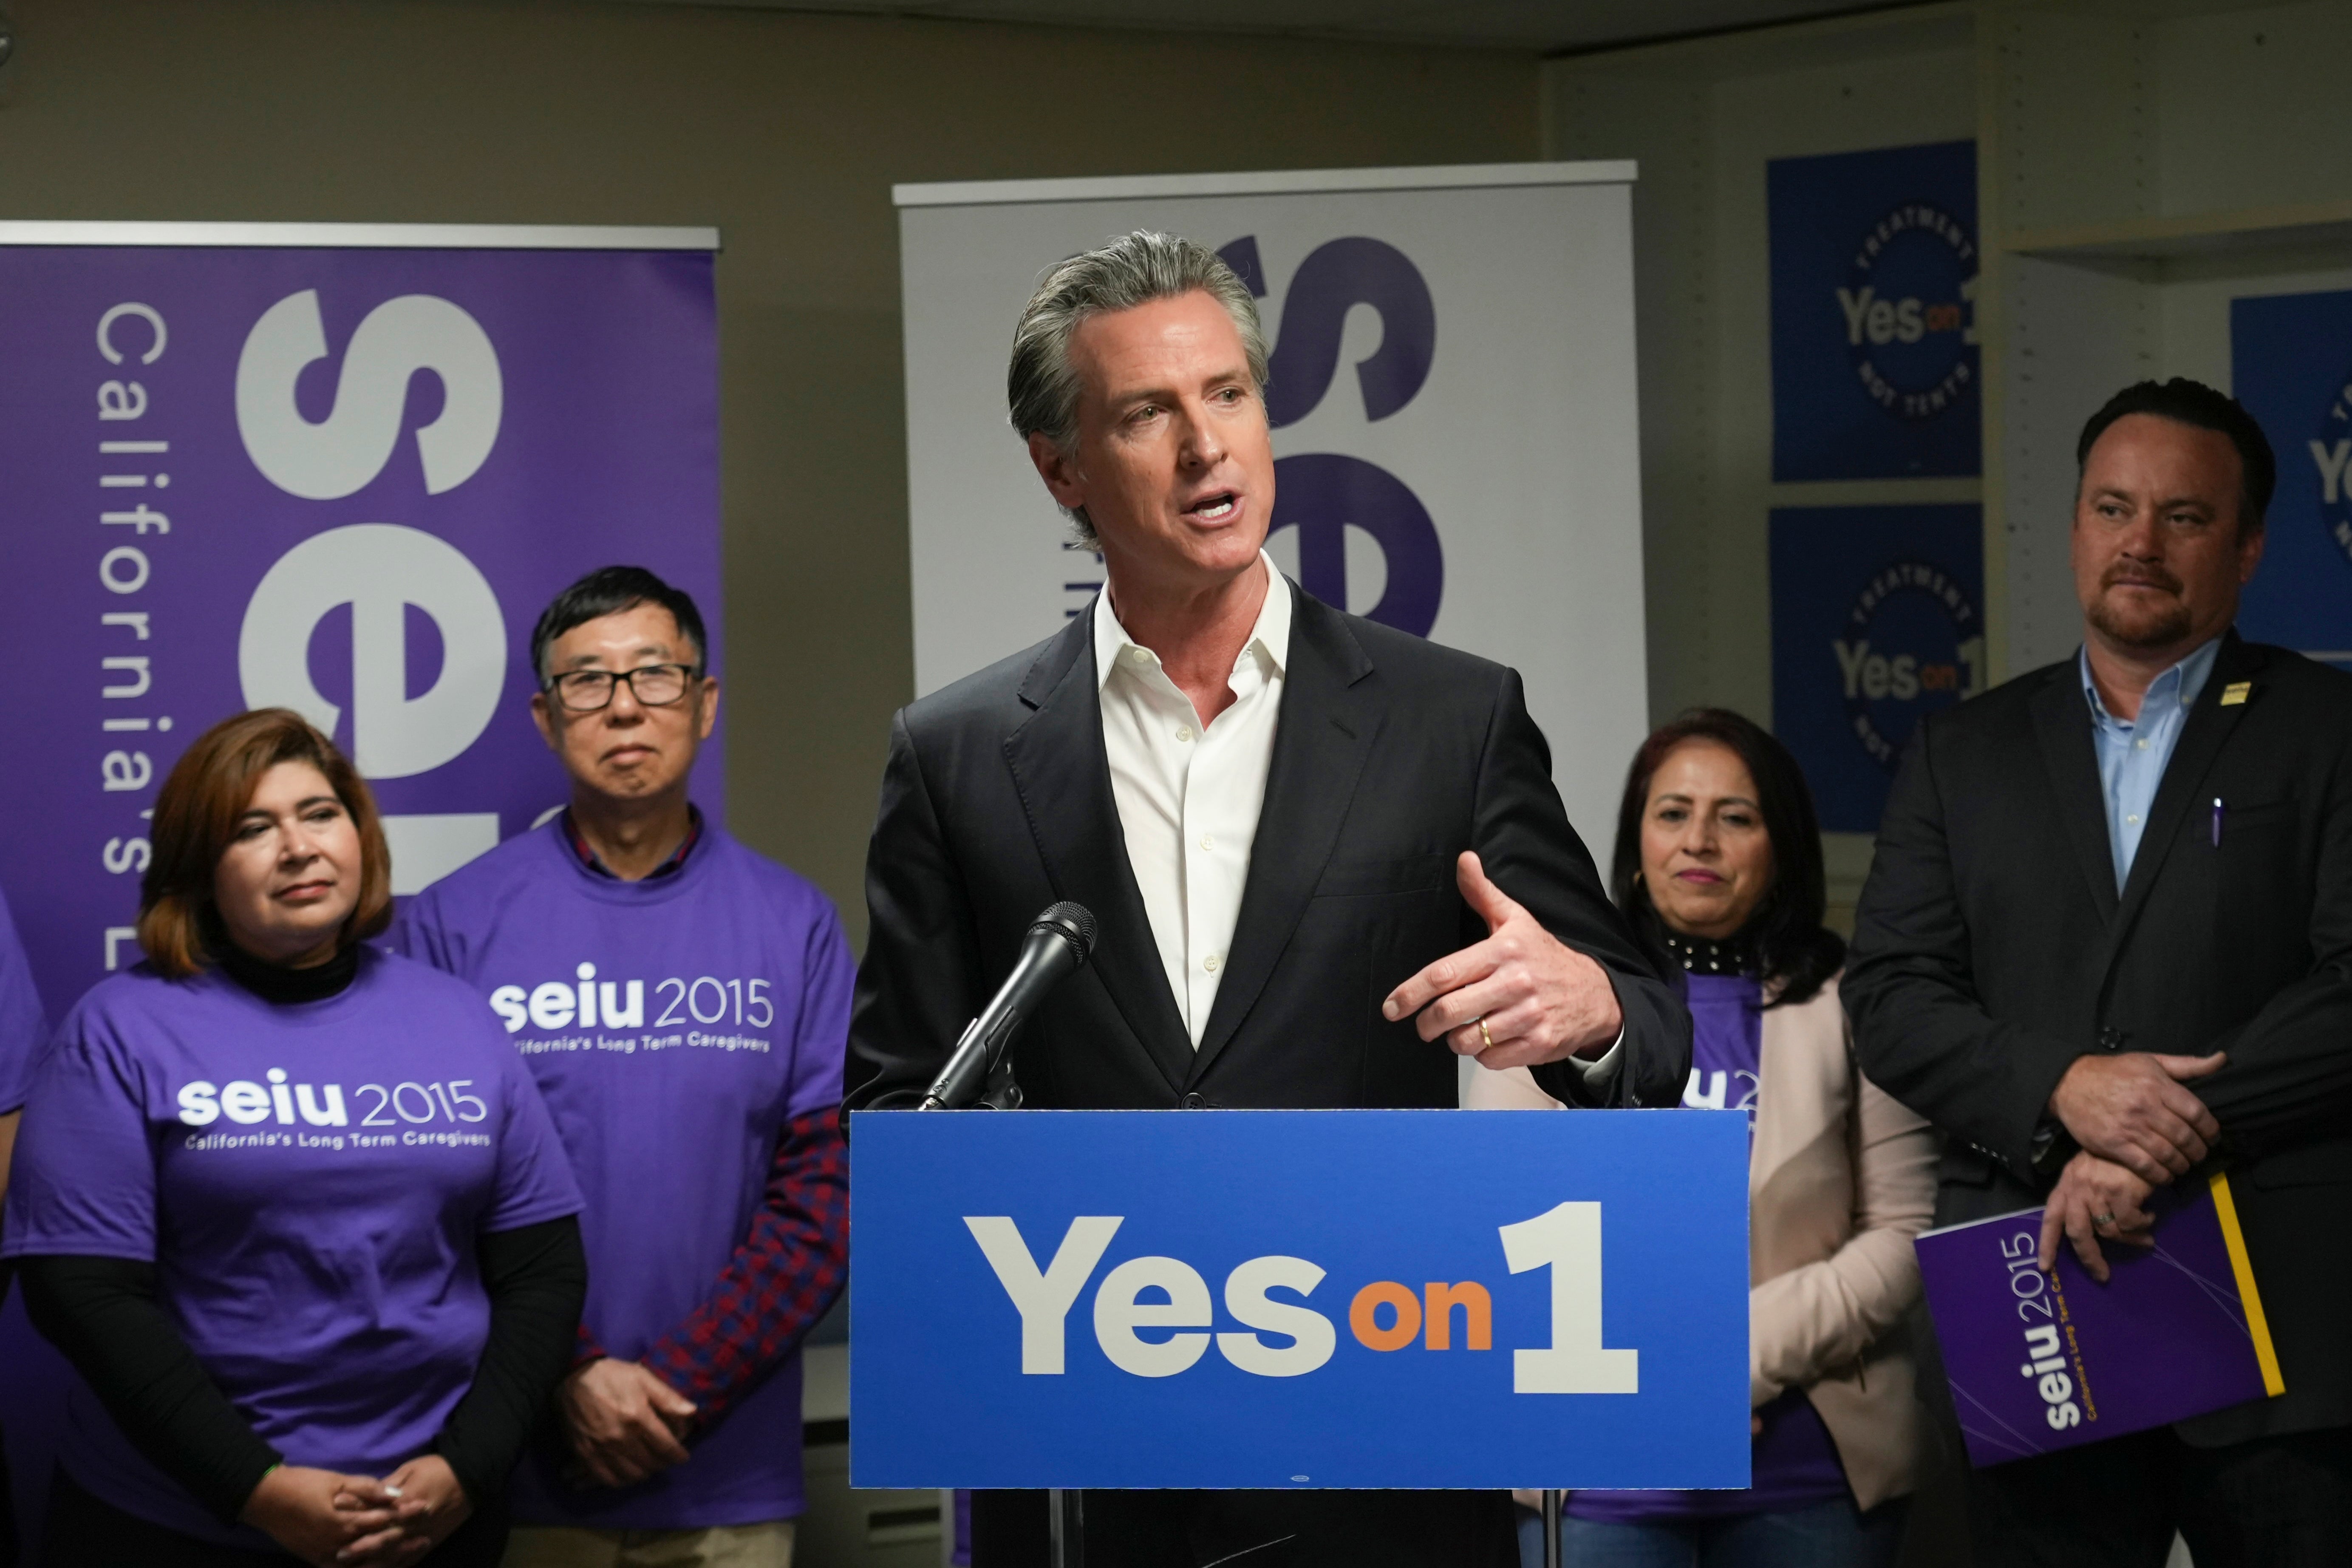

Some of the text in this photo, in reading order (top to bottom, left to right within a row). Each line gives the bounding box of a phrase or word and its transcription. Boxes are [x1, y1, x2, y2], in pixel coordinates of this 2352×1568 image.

[1836, 286, 1925, 345] Yes
[1927, 305, 1961, 331] on
[1858, 361, 1897, 407] NOT
[96, 301, 172, 874] California's
[1832, 639, 1920, 700] Yes
[1920, 664, 1957, 691] on
[490, 962, 774, 1033] seiu 2015
[597, 1033, 637, 1054] Long
[641, 1034, 682, 1050] Term
[687, 1030, 770, 1053] Caregivers
[178, 1067, 487, 1126] seiu 2015
[185, 1130, 491, 1151] California's Long Term Caregivers
[962, 1201, 1639, 1394] Yes on 1
[2000, 1231, 2081, 1431] seiu 2015
